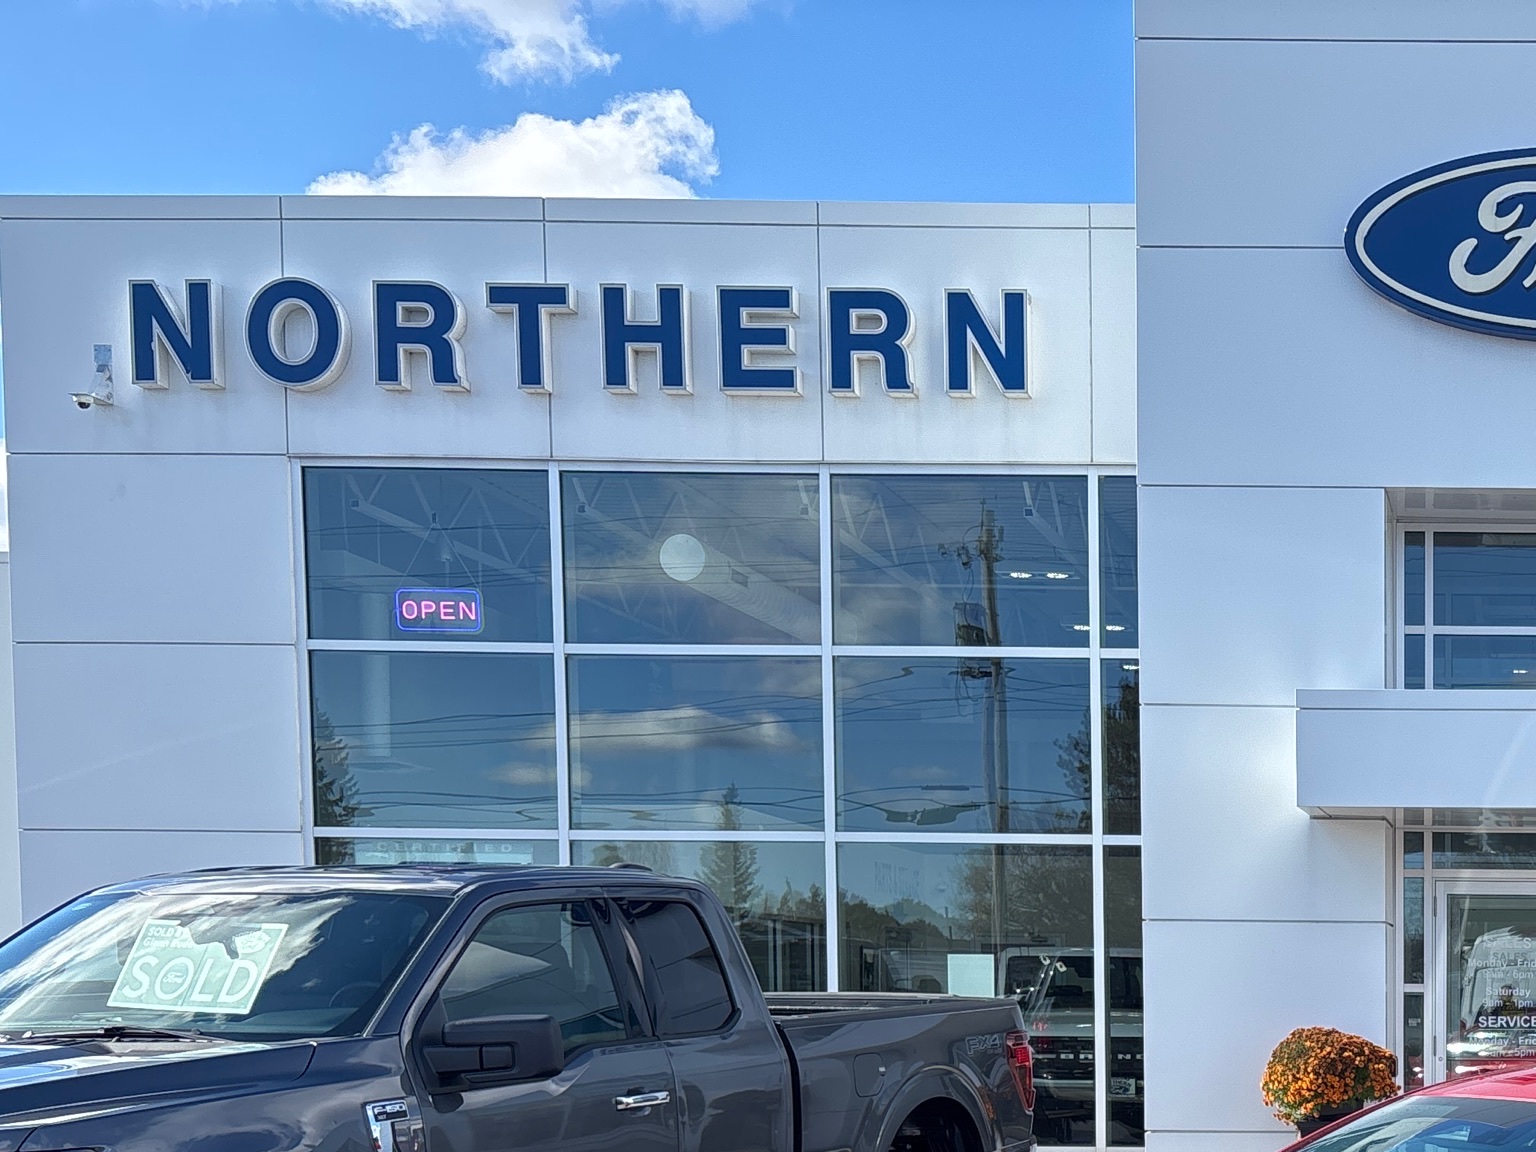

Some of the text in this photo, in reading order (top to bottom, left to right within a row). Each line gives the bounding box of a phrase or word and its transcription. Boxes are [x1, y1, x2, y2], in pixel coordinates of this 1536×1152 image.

[128, 277, 1033, 400] NORTHERN
[402, 600, 476, 620] OPEN
[121, 954, 258, 1003] SOLD
[1512, 970, 1534, 980] 6pm
[1485, 986, 1531, 998] Saturday
[1514, 998, 1534, 1009] 1pm
[965, 1033, 1001, 1055] FX4
[1514, 1047, 1535, 1057] 5pm
[373, 1103, 406, 1115] F-150
